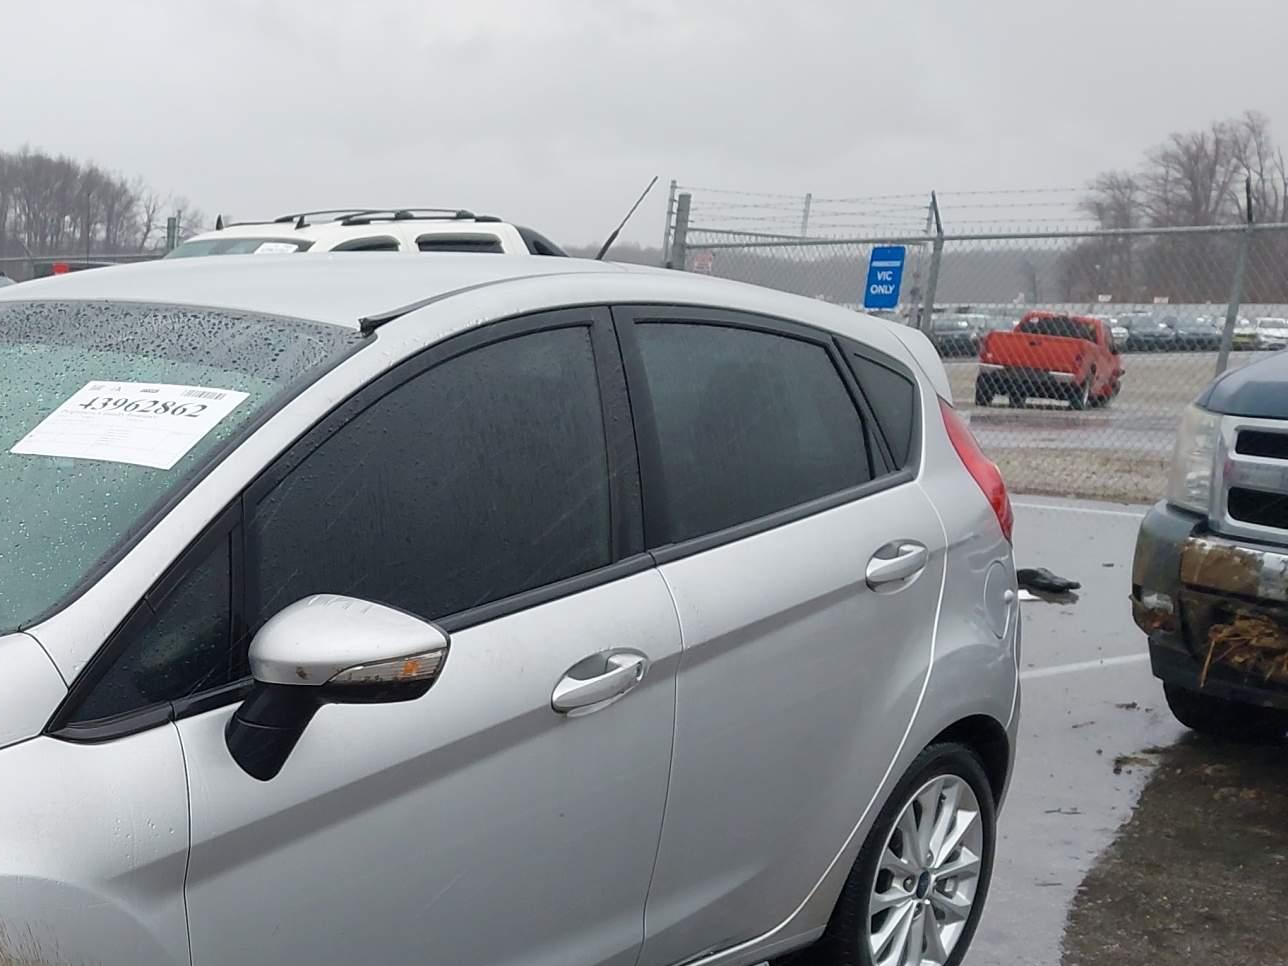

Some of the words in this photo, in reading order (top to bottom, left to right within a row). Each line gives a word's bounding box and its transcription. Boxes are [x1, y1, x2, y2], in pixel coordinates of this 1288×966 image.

[876, 270, 893, 281] VIC
[870, 284, 895, 295] ONLY
[79, 396, 208, 418] 43962862
